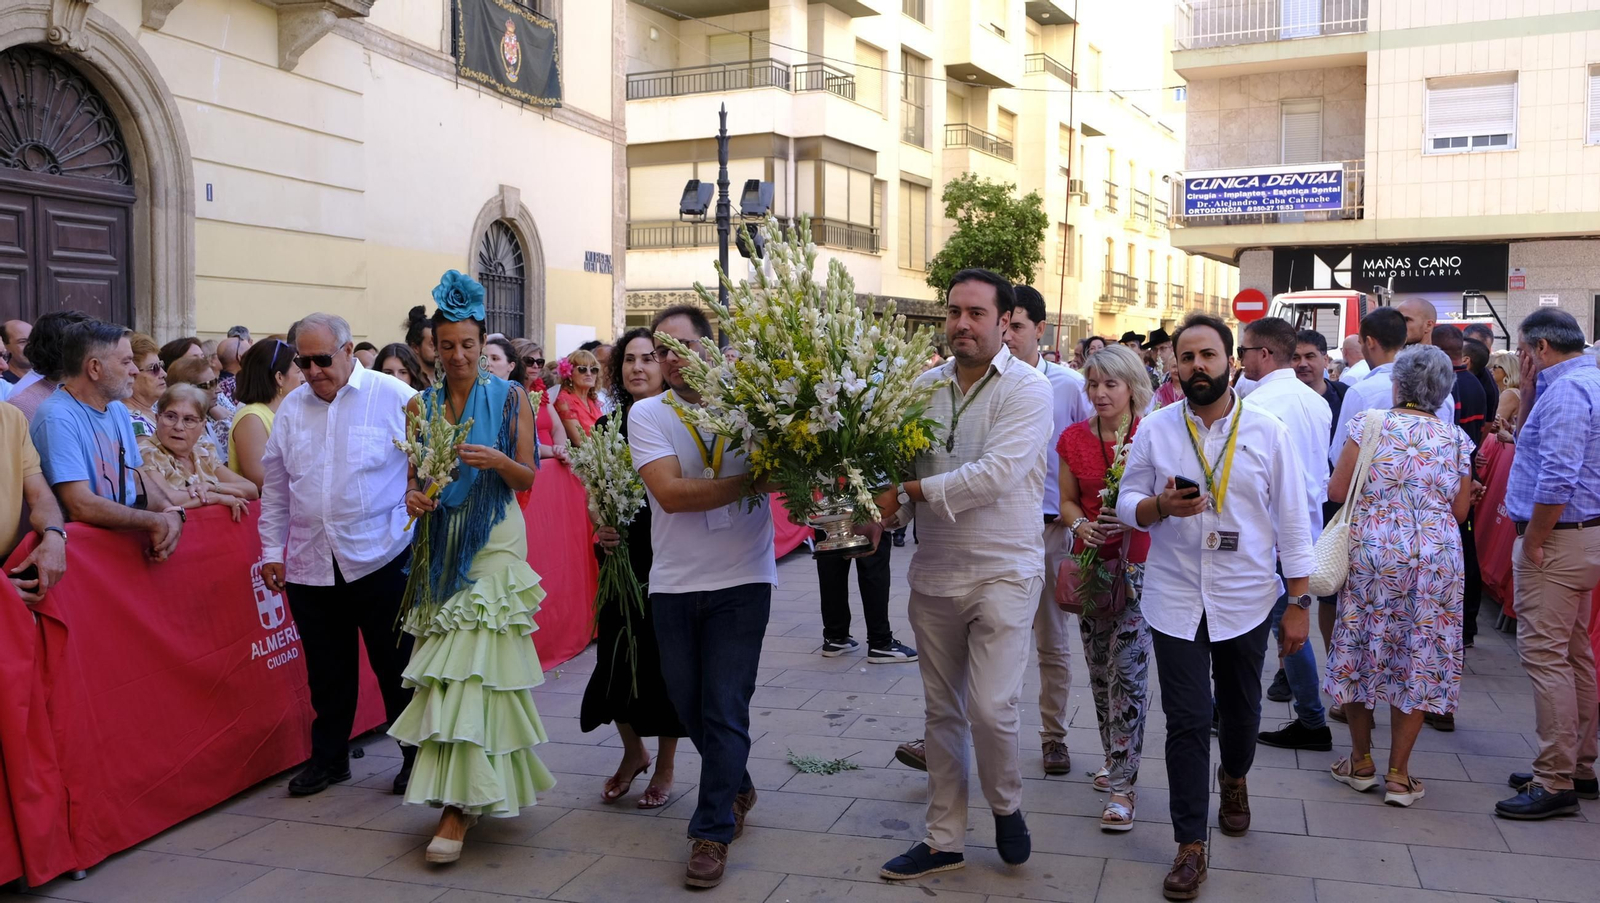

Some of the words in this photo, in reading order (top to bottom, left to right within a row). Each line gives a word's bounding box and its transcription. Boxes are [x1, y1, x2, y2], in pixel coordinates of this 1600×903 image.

[1189, 176, 1259, 190] CLINICA
[1266, 172, 1338, 186] DENTAL
[1224, 190, 1265, 199] Implantes
[1311, 185, 1340, 194] Dental
[1213, 199, 1258, 208] Alejandro
[1262, 197, 1286, 205] Caba
[1288, 195, 1331, 204] Calvache
[1362, 256, 1411, 269] MAÑAS
[1418, 256, 1462, 268] CANO
[1362, 269, 1461, 278] INMOBILIARIA
[251, 620, 301, 660] ALMERÍ
[267, 647, 298, 670] CIUDAD
